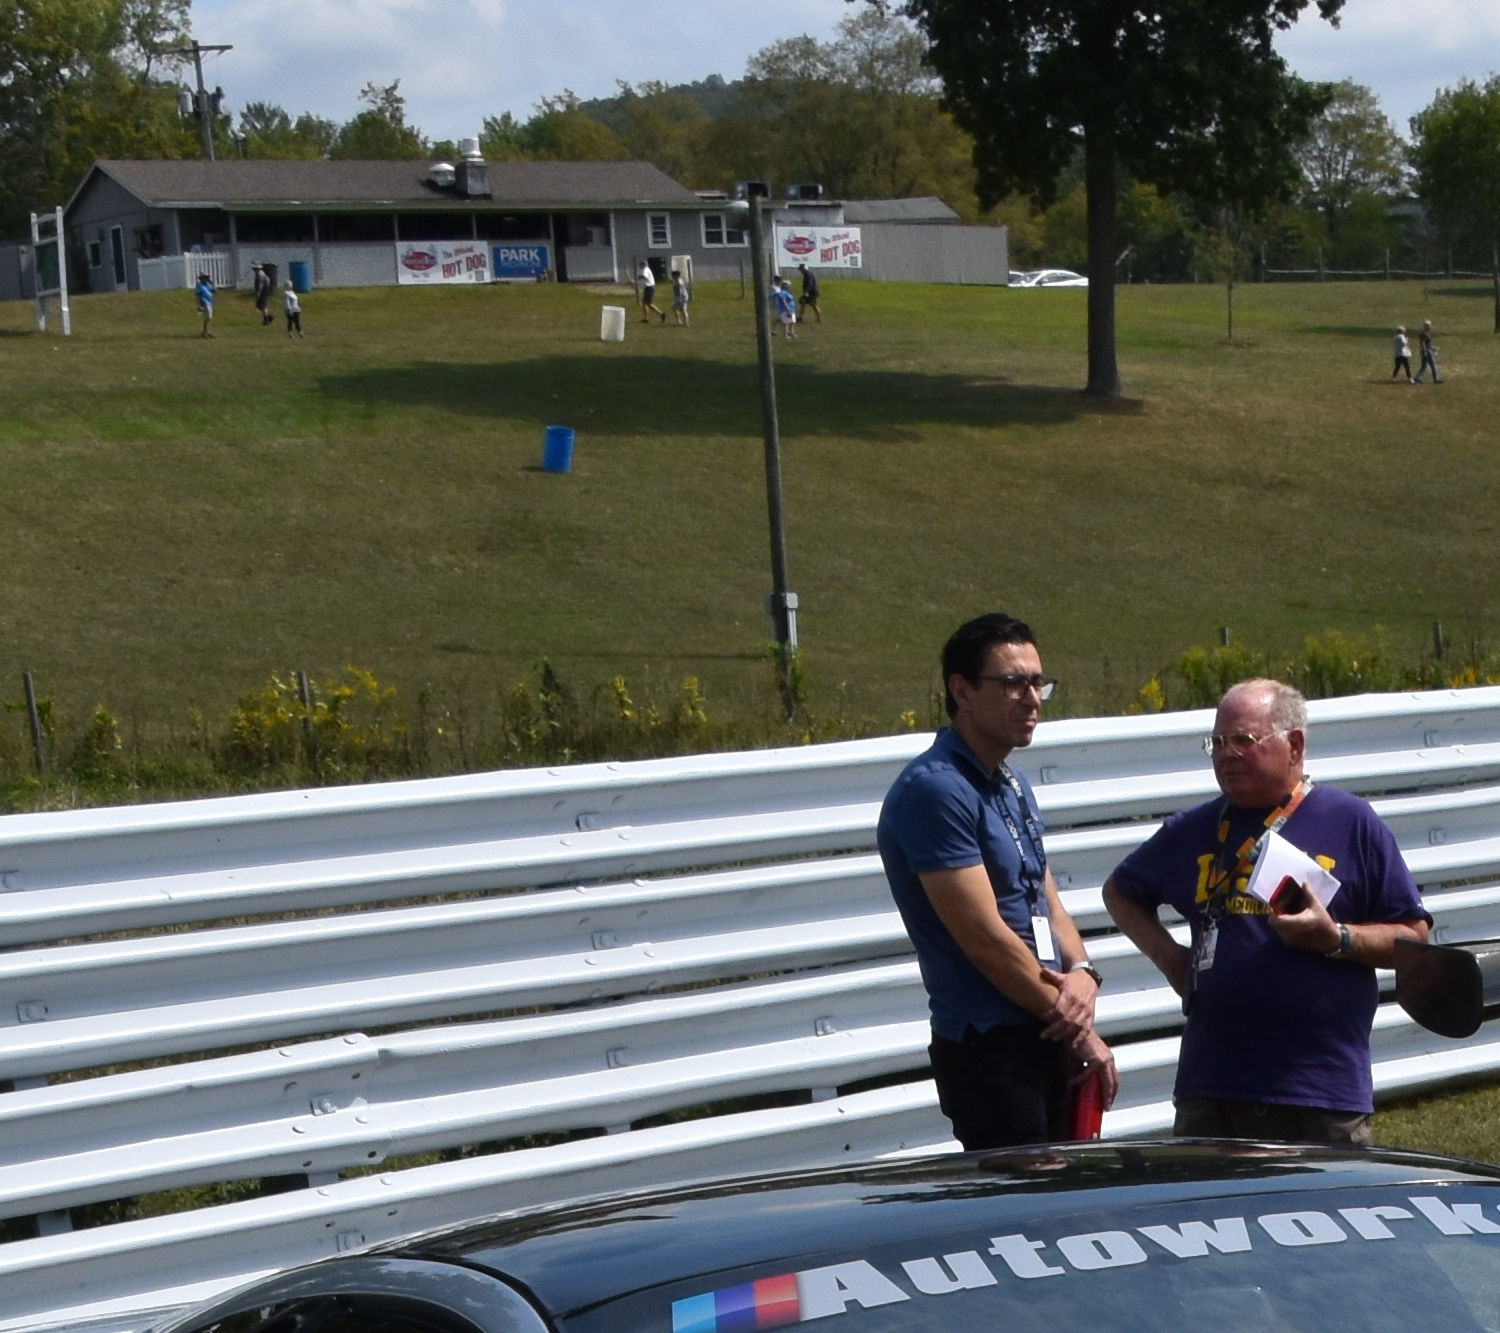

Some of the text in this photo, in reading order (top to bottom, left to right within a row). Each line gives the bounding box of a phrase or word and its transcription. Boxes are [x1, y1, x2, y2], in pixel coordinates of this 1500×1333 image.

[500, 249, 540, 261] PARK
[442, 260, 462, 279] HOT
[466, 253, 487, 271] DOG
